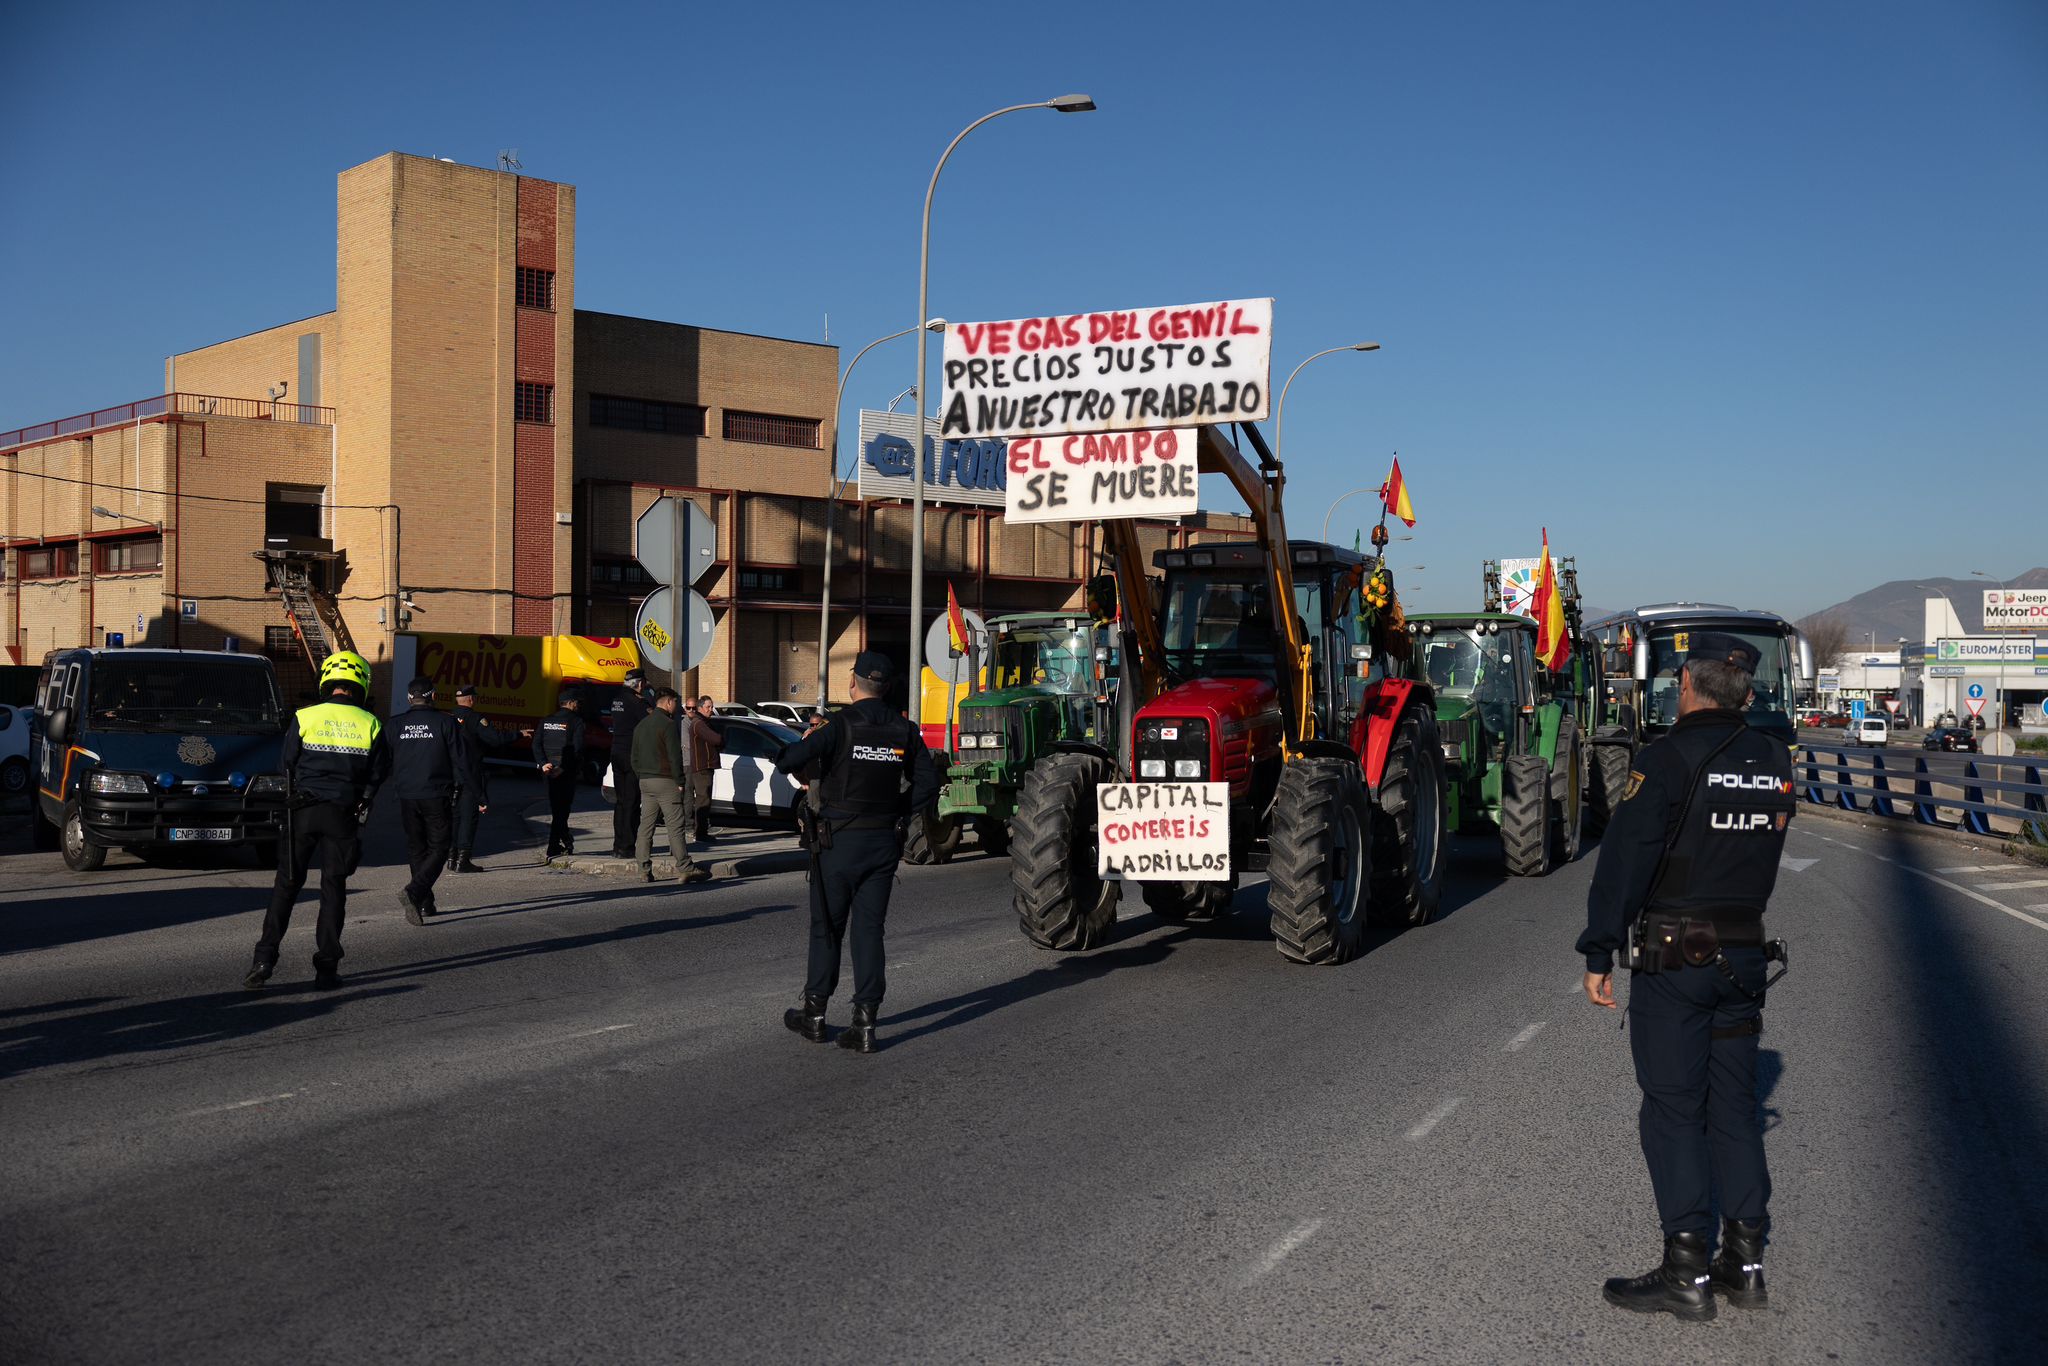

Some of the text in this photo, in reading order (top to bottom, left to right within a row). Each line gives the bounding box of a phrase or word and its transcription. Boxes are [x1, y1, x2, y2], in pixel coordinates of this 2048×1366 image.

[957, 313, 1083, 355] VEGAS
[1088, 311, 1141, 344] DEL
[1094, 340, 1232, 375] JUSTOS
[941, 380, 1261, 436] A NUESTRO TRABAJO
[1008, 429, 1178, 474] EL CAMPO
[1018, 463, 1196, 511] SE MUERE
[2018, 593, 2046, 604] Jeep
[1960, 645, 2031, 655] EUROMASTER
[420, 636, 528, 690] CARIÑO
[597, 657, 636, 668] CARIÑO
[316, 729, 363, 741] GRANADA
[400, 732, 434, 740] GRANADA
[852, 752, 903, 762] NACIONAL
[853, 745, 896, 755] POLICIA
[1707, 773, 1784, 790] POLICIA
[1711, 812, 1772, 830] U.I.P.
